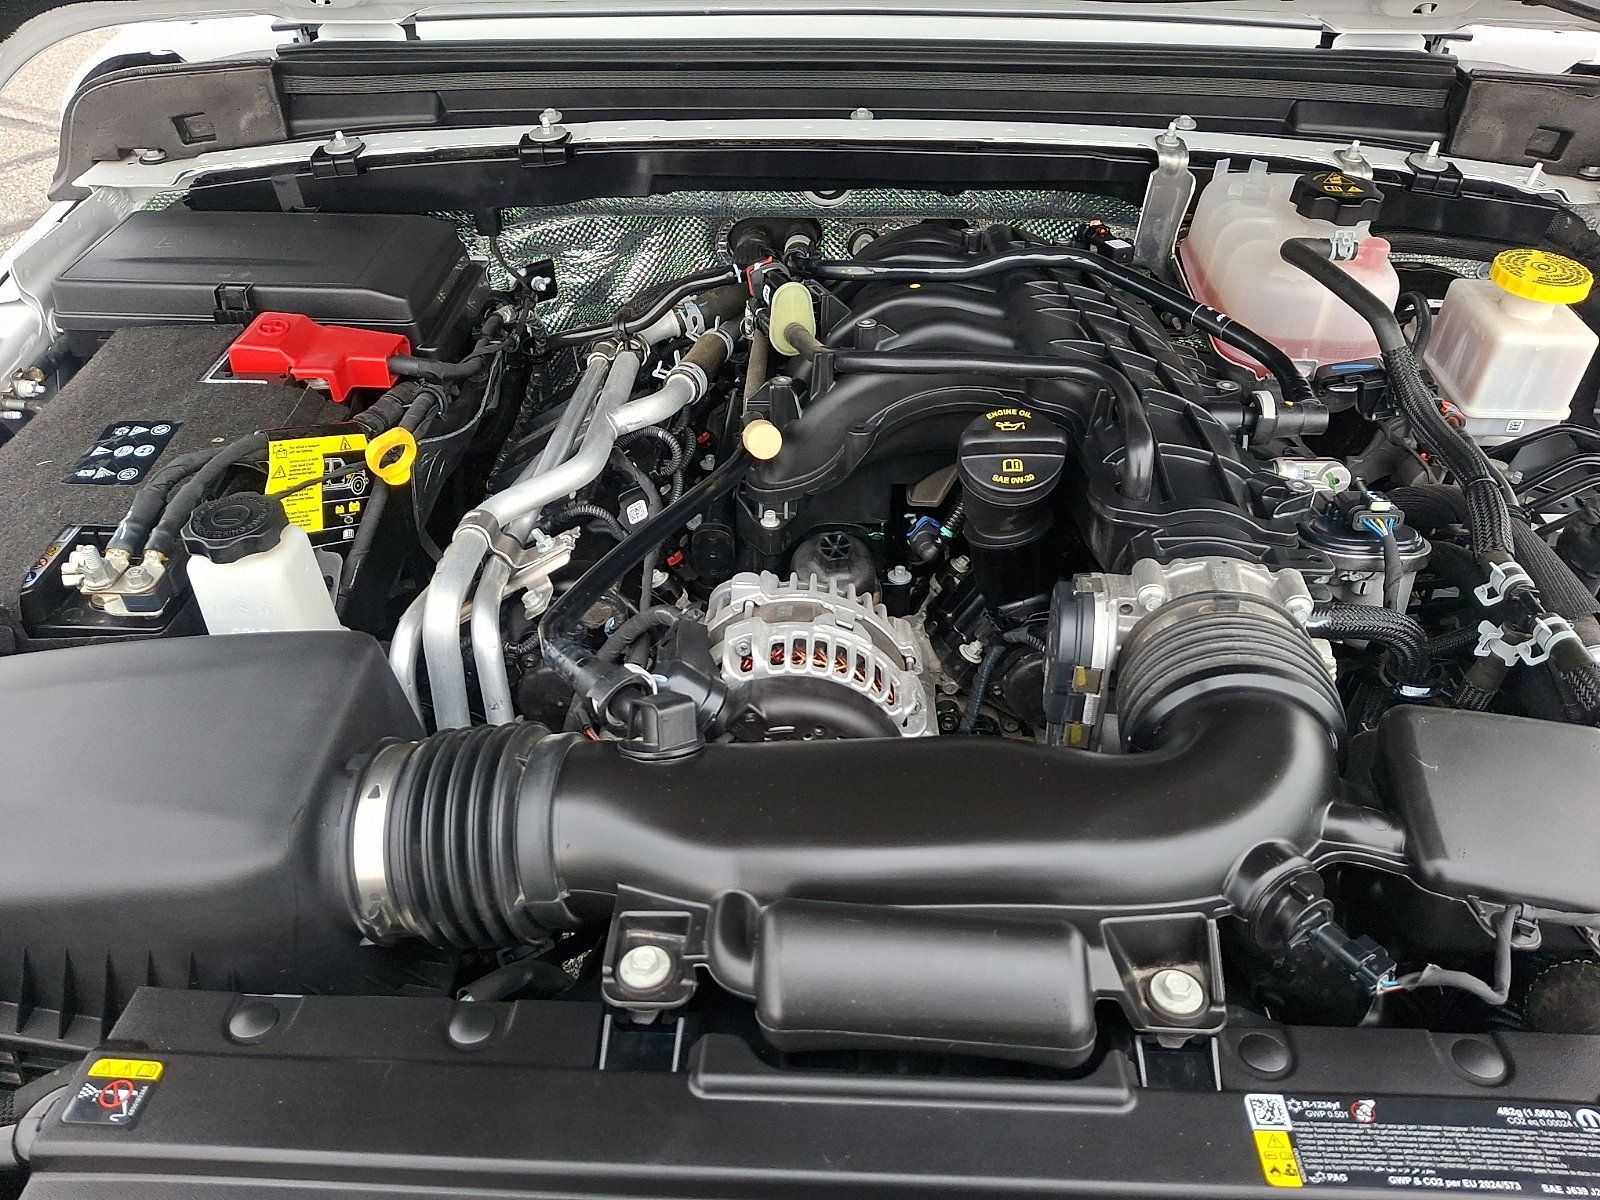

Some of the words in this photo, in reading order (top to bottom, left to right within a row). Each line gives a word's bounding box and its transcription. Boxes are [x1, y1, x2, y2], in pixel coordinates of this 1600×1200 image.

[986, 409, 1017, 420] ENGINE
[1019, 410, 1032, 419] OIL
[992, 474, 1009, 484] SAE
[1010, 473, 1035, 484] 0W-20
[1302, 1100, 1340, 1111] R-1234yf
[1305, 1110, 1326, 1118] GWP
[1327, 1110, 1349, 1118] 0.501
[1555, 1109, 1572, 1120] lb)
[1507, 1116, 1526, 1126] CO2
[1326, 1173, 1348, 1182] PAG
[1387, 1175, 1412, 1185] GWP
[1424, 1177, 1444, 1187] CO2
[1445, 1179, 1460, 1188] per
[1462, 1179, 1478, 1188] EU
[1479, 1180, 1522, 1190] 2024/573
[1541, 1184, 1565, 1194] SAE
[1565, 1186, 1589, 1195] J639
